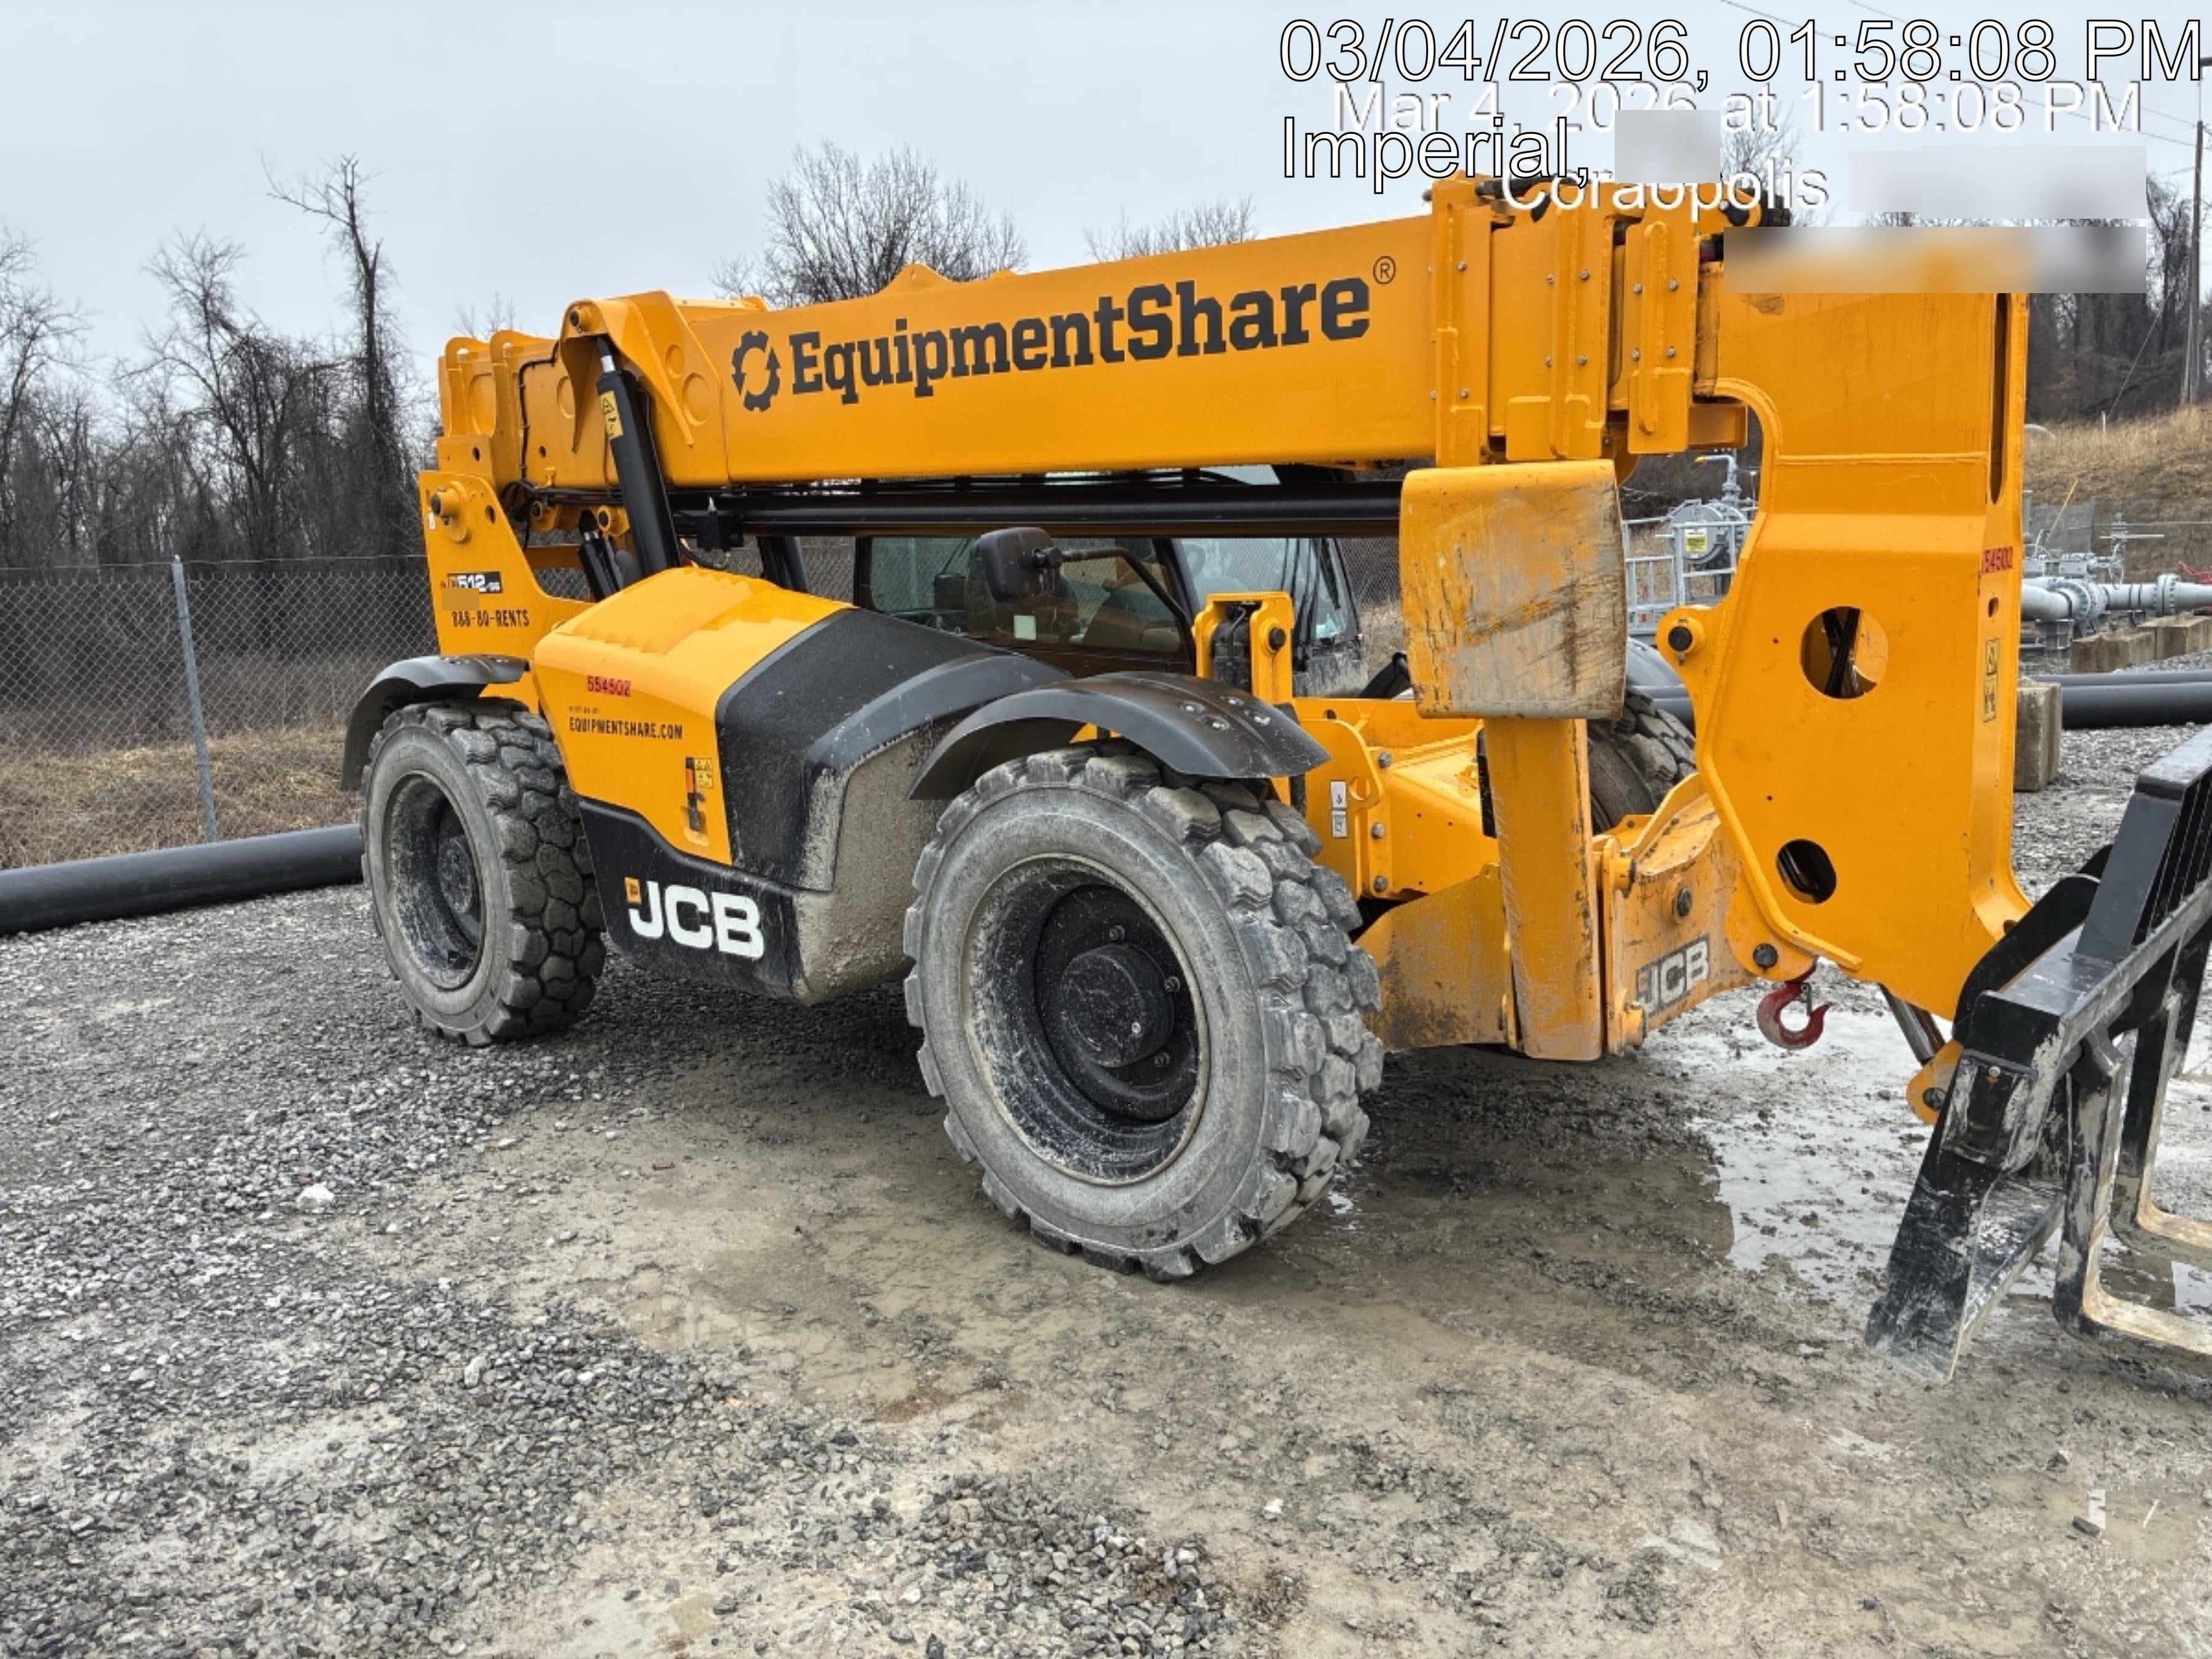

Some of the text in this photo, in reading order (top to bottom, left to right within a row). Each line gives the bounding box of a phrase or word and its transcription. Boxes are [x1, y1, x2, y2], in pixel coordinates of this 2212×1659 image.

[788, 275, 1369, 405] EquipmentShare
[587, 676, 632, 697] 554502
[569, 716, 683, 740] EQUIPMENTSHARE.COM
[628, 880, 764, 960] JCB
[1637, 941, 1709, 1016] JCB
